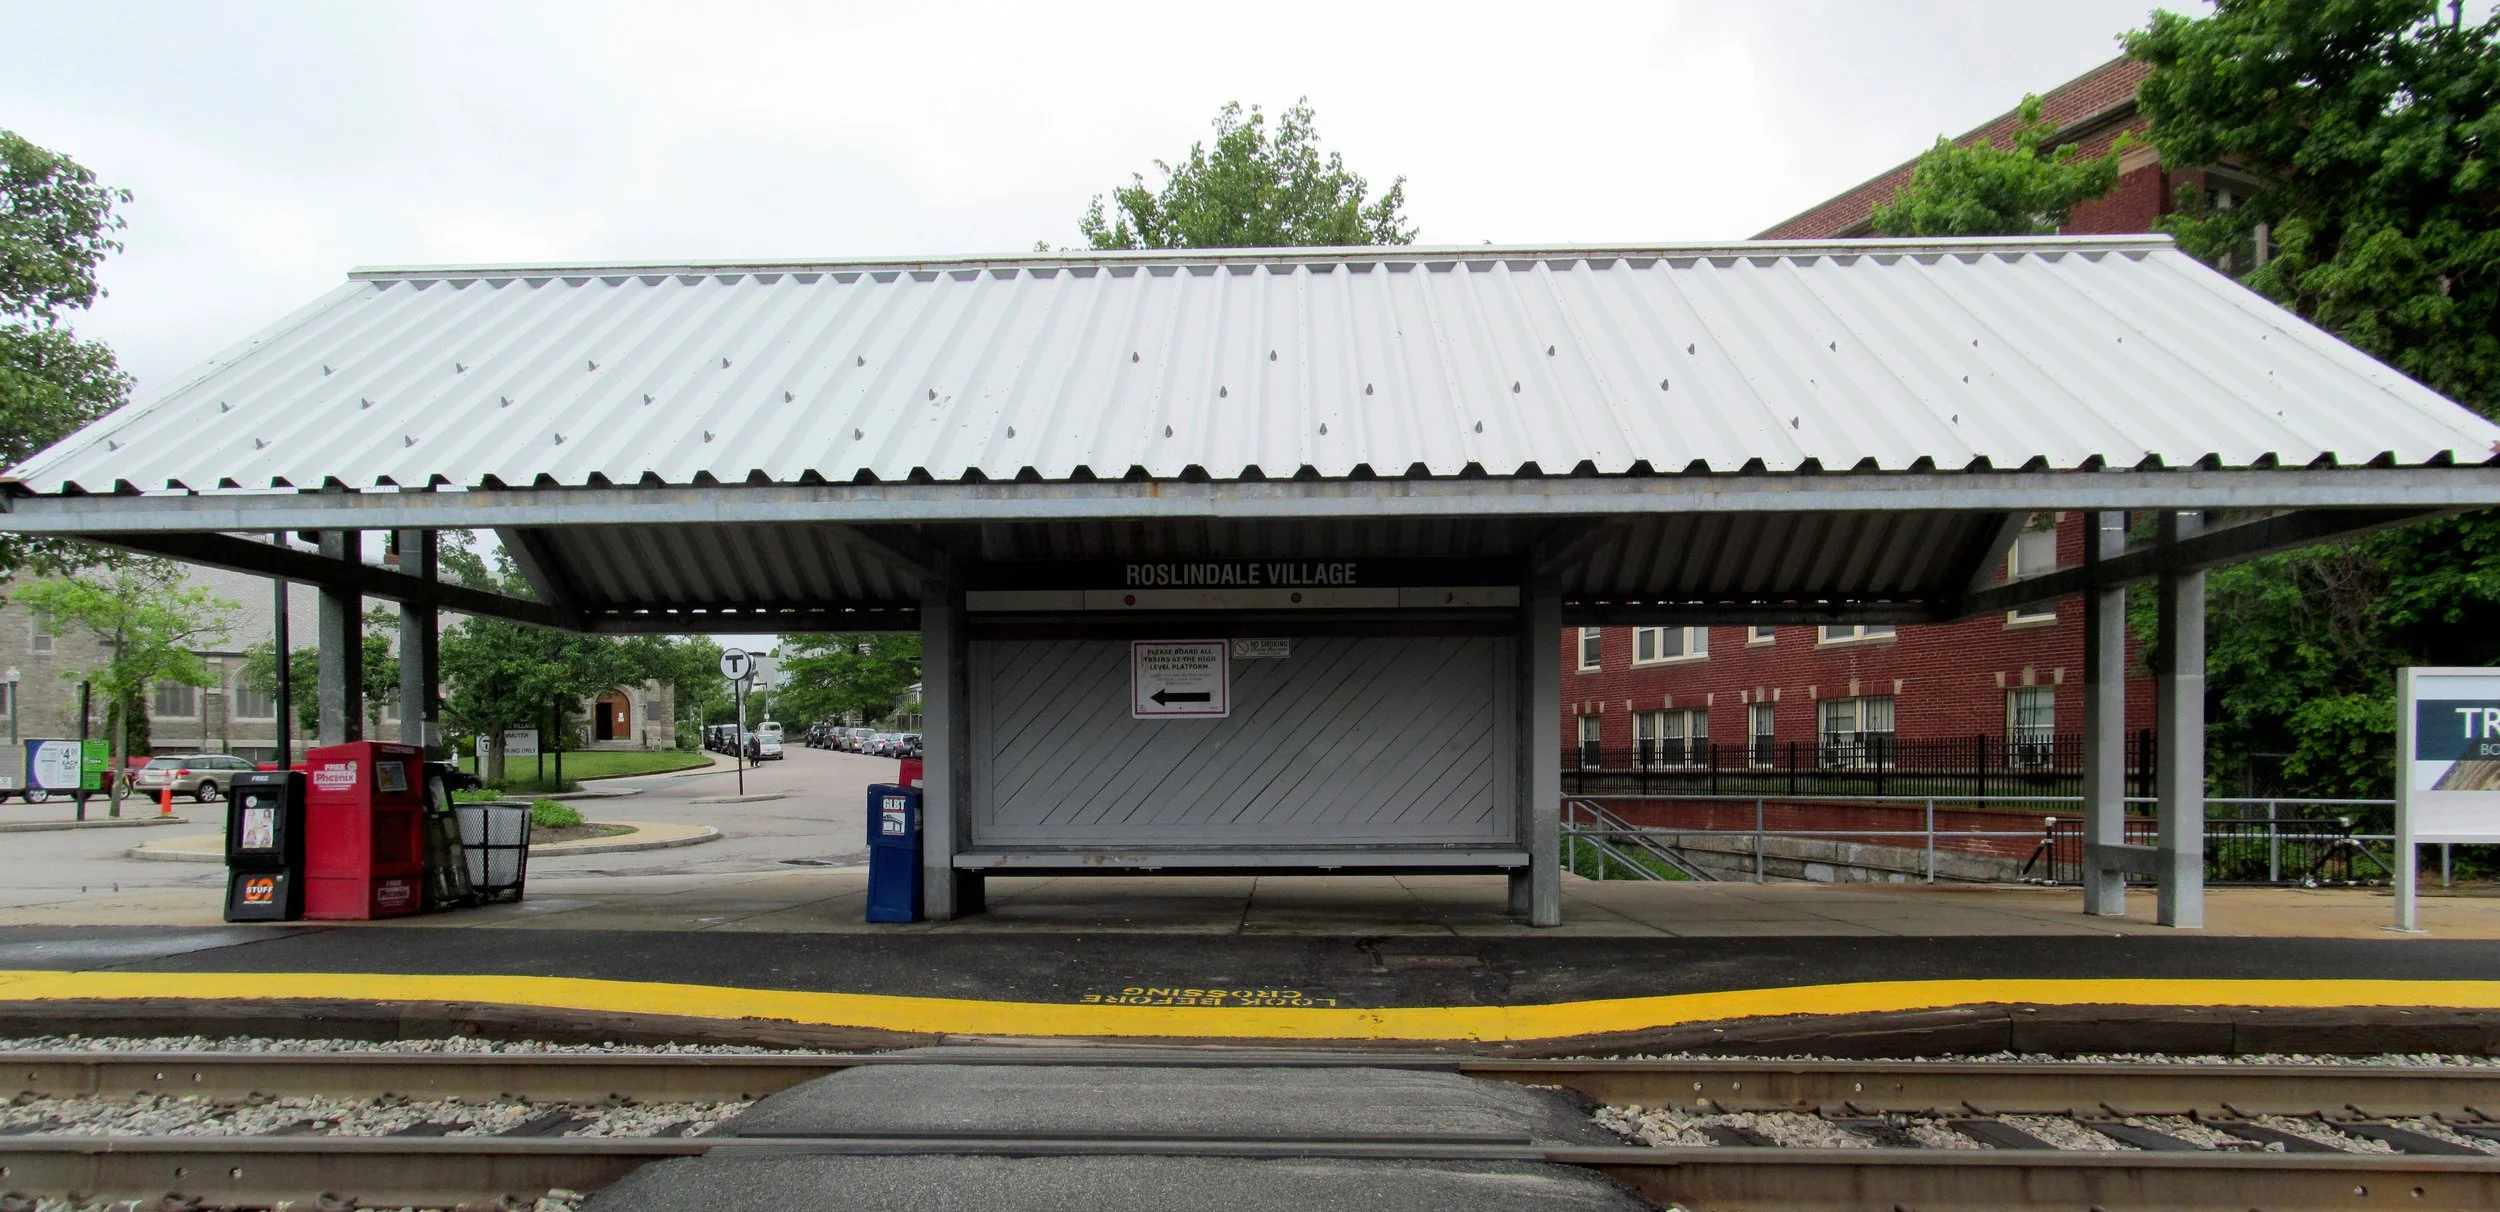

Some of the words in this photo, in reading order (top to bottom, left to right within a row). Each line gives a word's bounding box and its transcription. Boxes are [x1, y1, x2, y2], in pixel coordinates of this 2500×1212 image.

[1126, 563, 1260, 585] ROSLINDALE
[1267, 563, 1357, 585] VILLAGE
[1250, 640, 1259, 648] NO
[1260, 640, 1288, 648] SMOKING
[725, 654, 744, 673] T
[324, 763, 347, 771] FREE
[316, 772, 355, 782] Phoenix
[882, 798, 906, 810] GLBT
[246, 885, 274, 894] STUFF
[1123, 987, 1303, 999] CROSSING
[1080, 994, 1221, 1006] BEFORE
[1241, 998, 1337, 1007] LOOK
